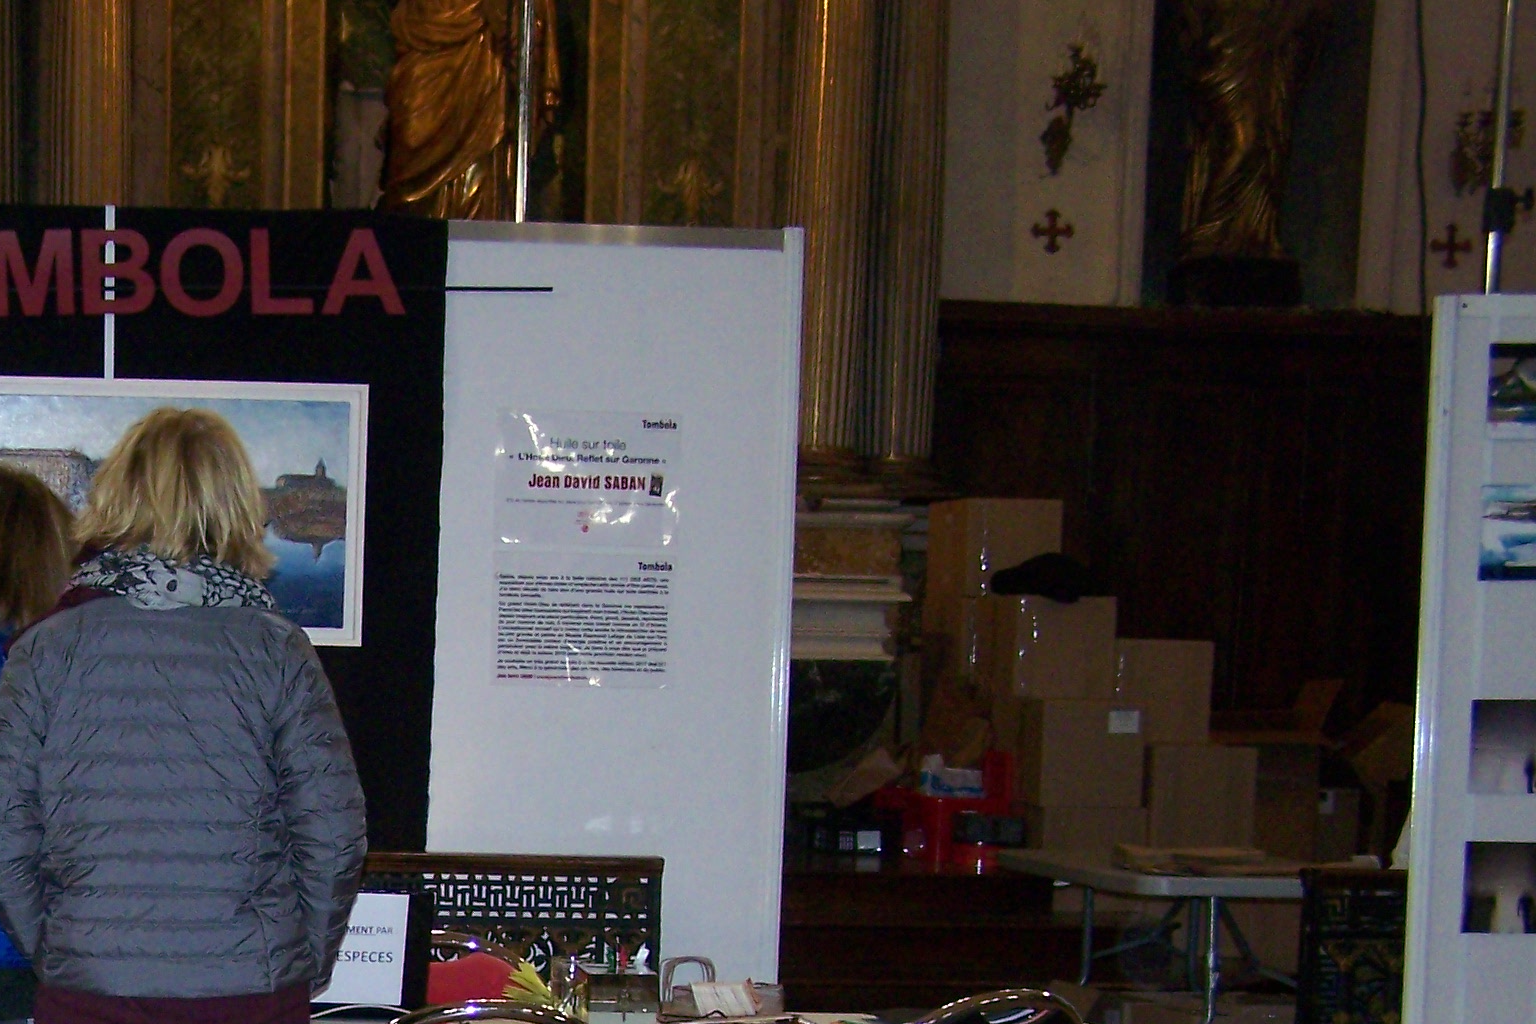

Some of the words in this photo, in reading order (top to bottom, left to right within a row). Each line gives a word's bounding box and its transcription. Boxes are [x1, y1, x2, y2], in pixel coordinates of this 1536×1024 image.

[642, 419, 677, 430] Tombola
[582, 440, 600, 450] sur
[528, 473, 560, 489] Jean
[564, 474, 600, 490] David
[604, 475, 646, 491] SABAN
[638, 562, 673, 572] Tombola
[376, 926, 394, 935] PAR
[336, 950, 394, 963] ESPECES
